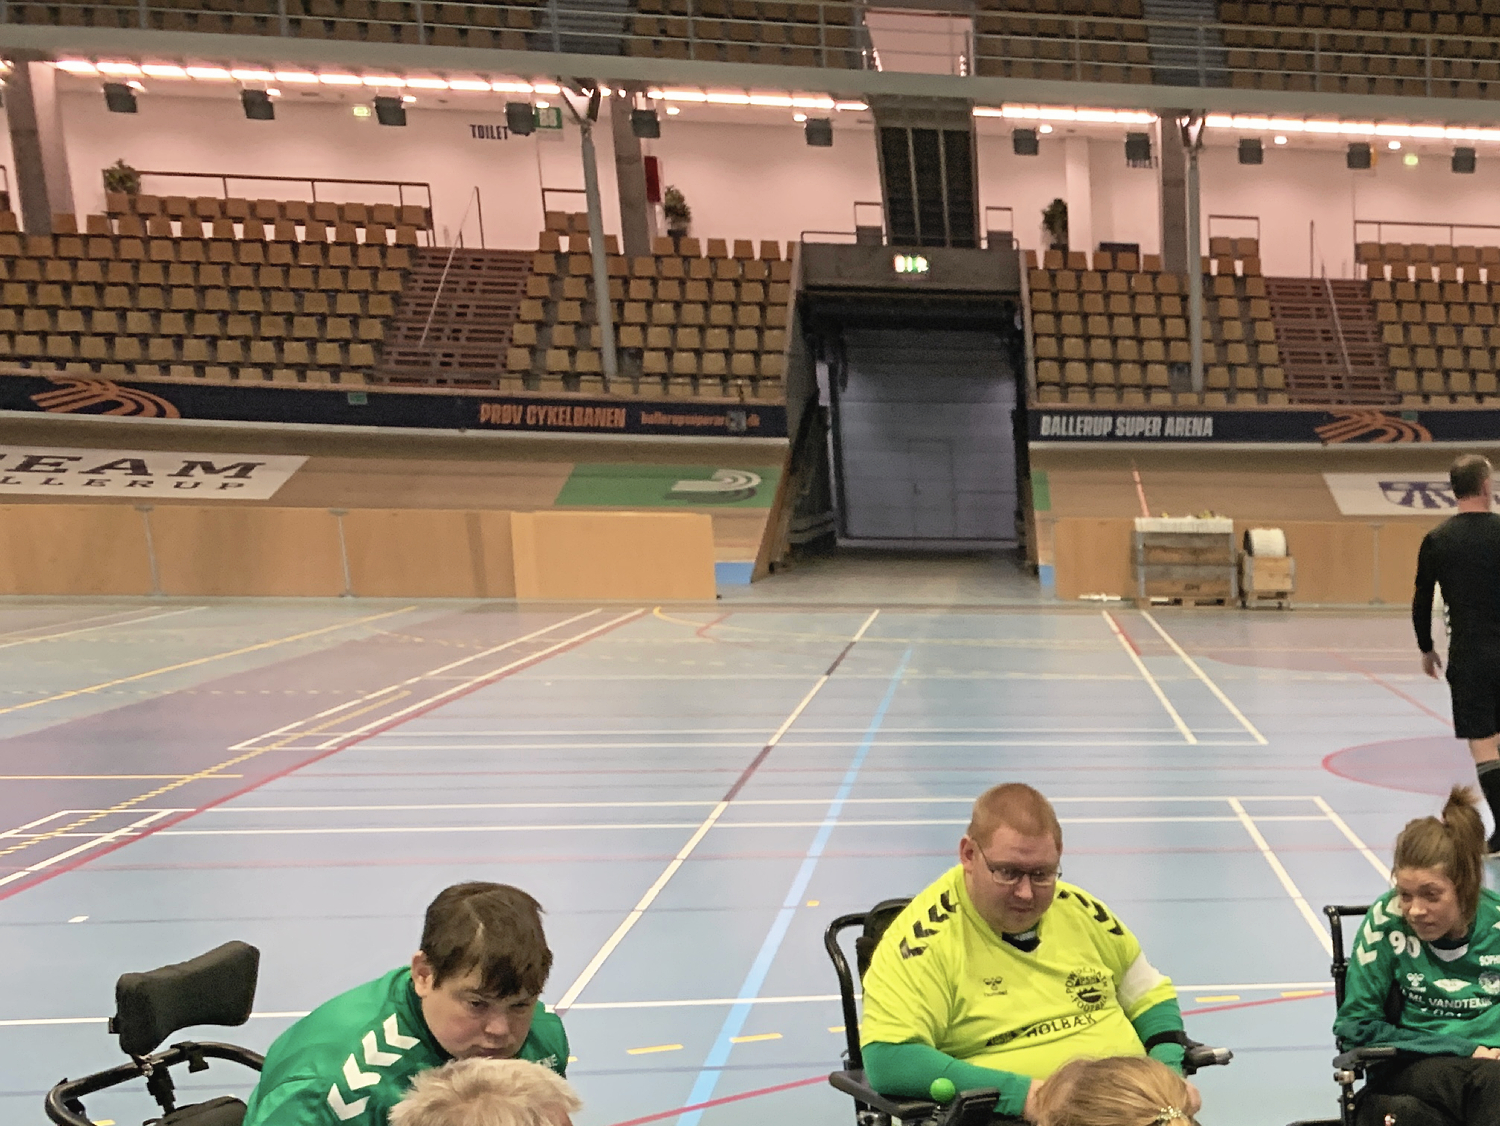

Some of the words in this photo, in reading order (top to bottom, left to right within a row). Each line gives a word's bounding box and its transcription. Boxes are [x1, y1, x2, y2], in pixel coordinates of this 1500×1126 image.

[470, 124, 508, 140] TOILET
[526, 405, 626, 428] CYKELBANEN
[1041, 415, 1113, 436] BALLERUP
[1115, 416, 1163, 437] SUPER
[1164, 416, 1214, 437] ARENA
[0, 454, 266, 479] EAM
[1388, 930, 1421, 959] 90
